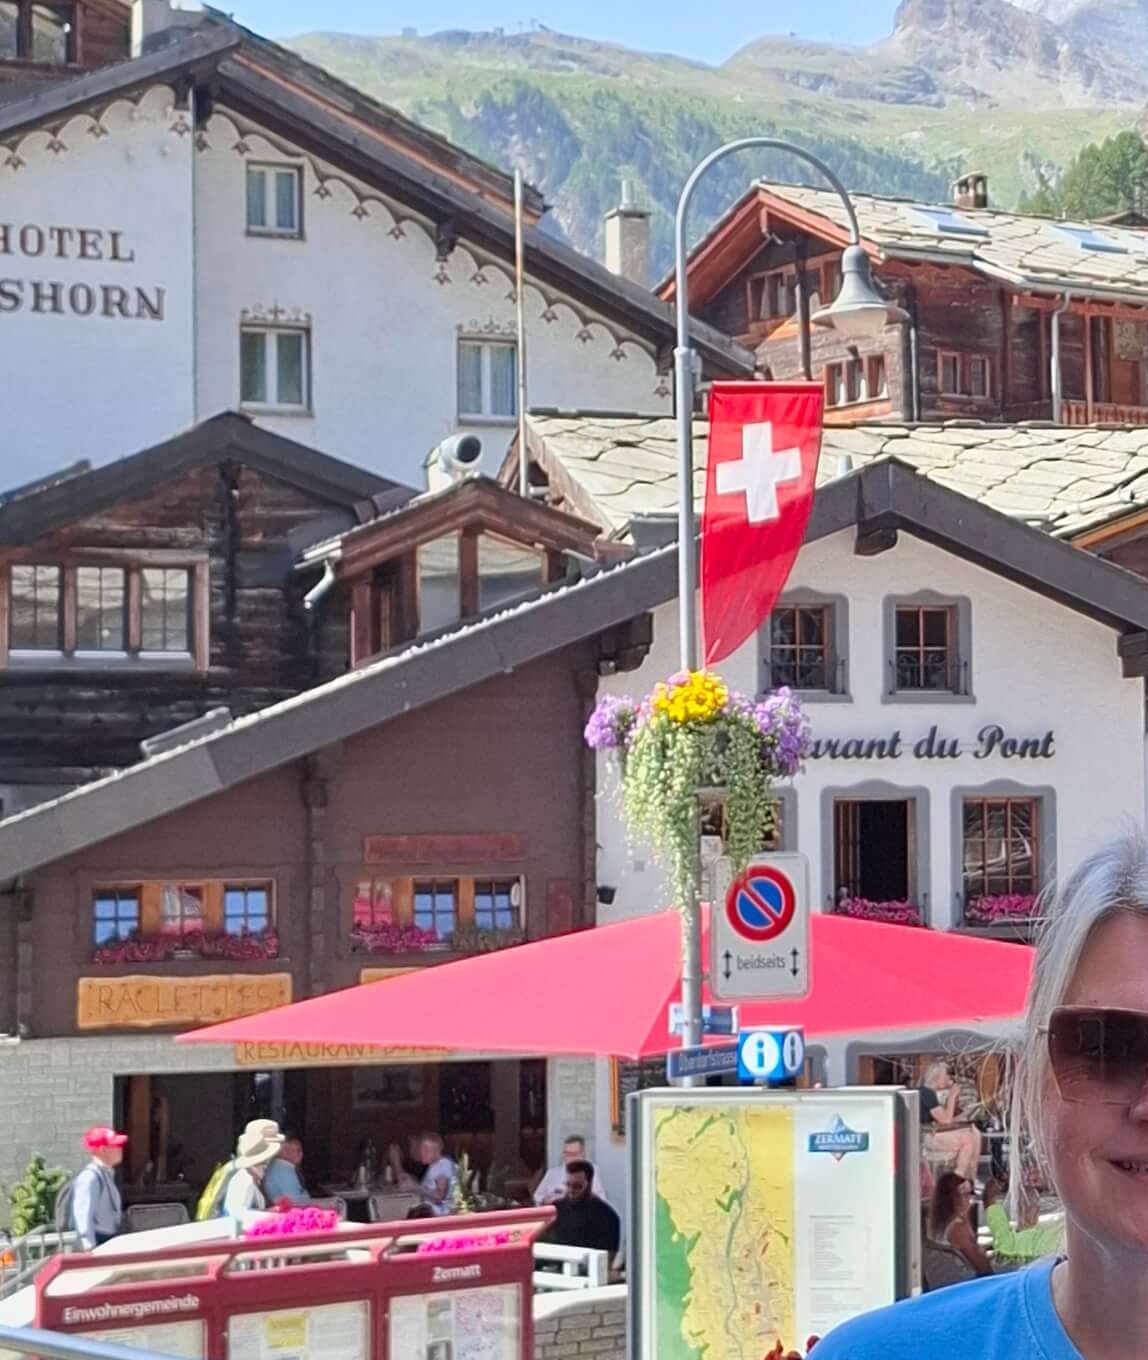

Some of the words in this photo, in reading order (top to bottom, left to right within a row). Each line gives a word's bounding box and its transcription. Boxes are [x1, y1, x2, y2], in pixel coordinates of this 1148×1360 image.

[913, 725, 962, 760] du
[972, 724, 1056, 760] Pont
[736, 953, 787, 971] beidseits
[431, 1263, 482, 1282] Zermatt
[63, 1293, 200, 1323] Einwohnergemeinde
